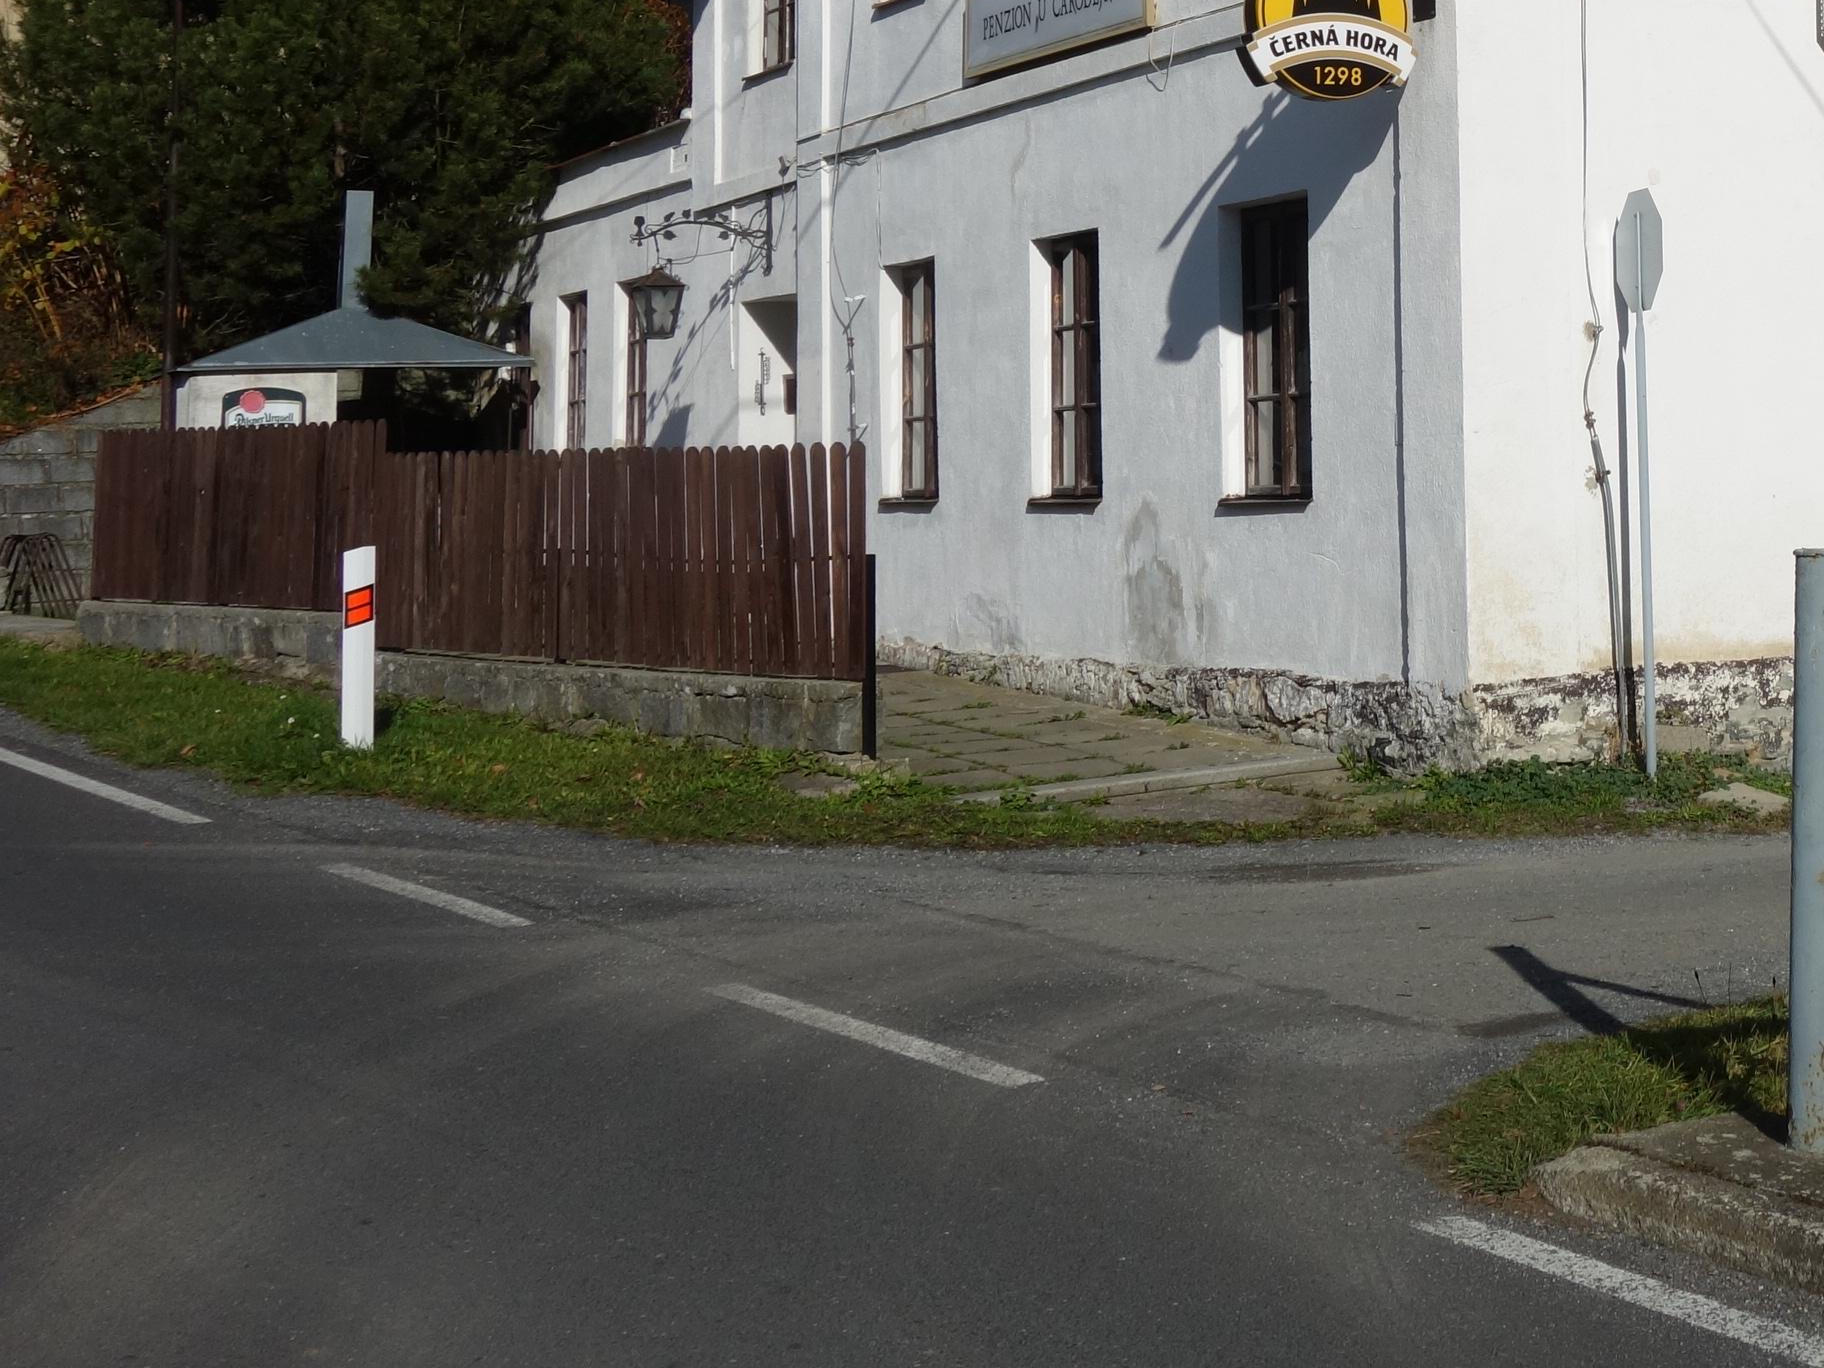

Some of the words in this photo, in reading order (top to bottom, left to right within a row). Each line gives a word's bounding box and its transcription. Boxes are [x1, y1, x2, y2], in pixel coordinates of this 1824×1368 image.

[982, 1, 1032, 40] PENZION
[1268, 24, 1340, 57] ČERNÁ
[1345, 29, 1399, 62] HORA
[1313, 66, 1362, 86] 1298
